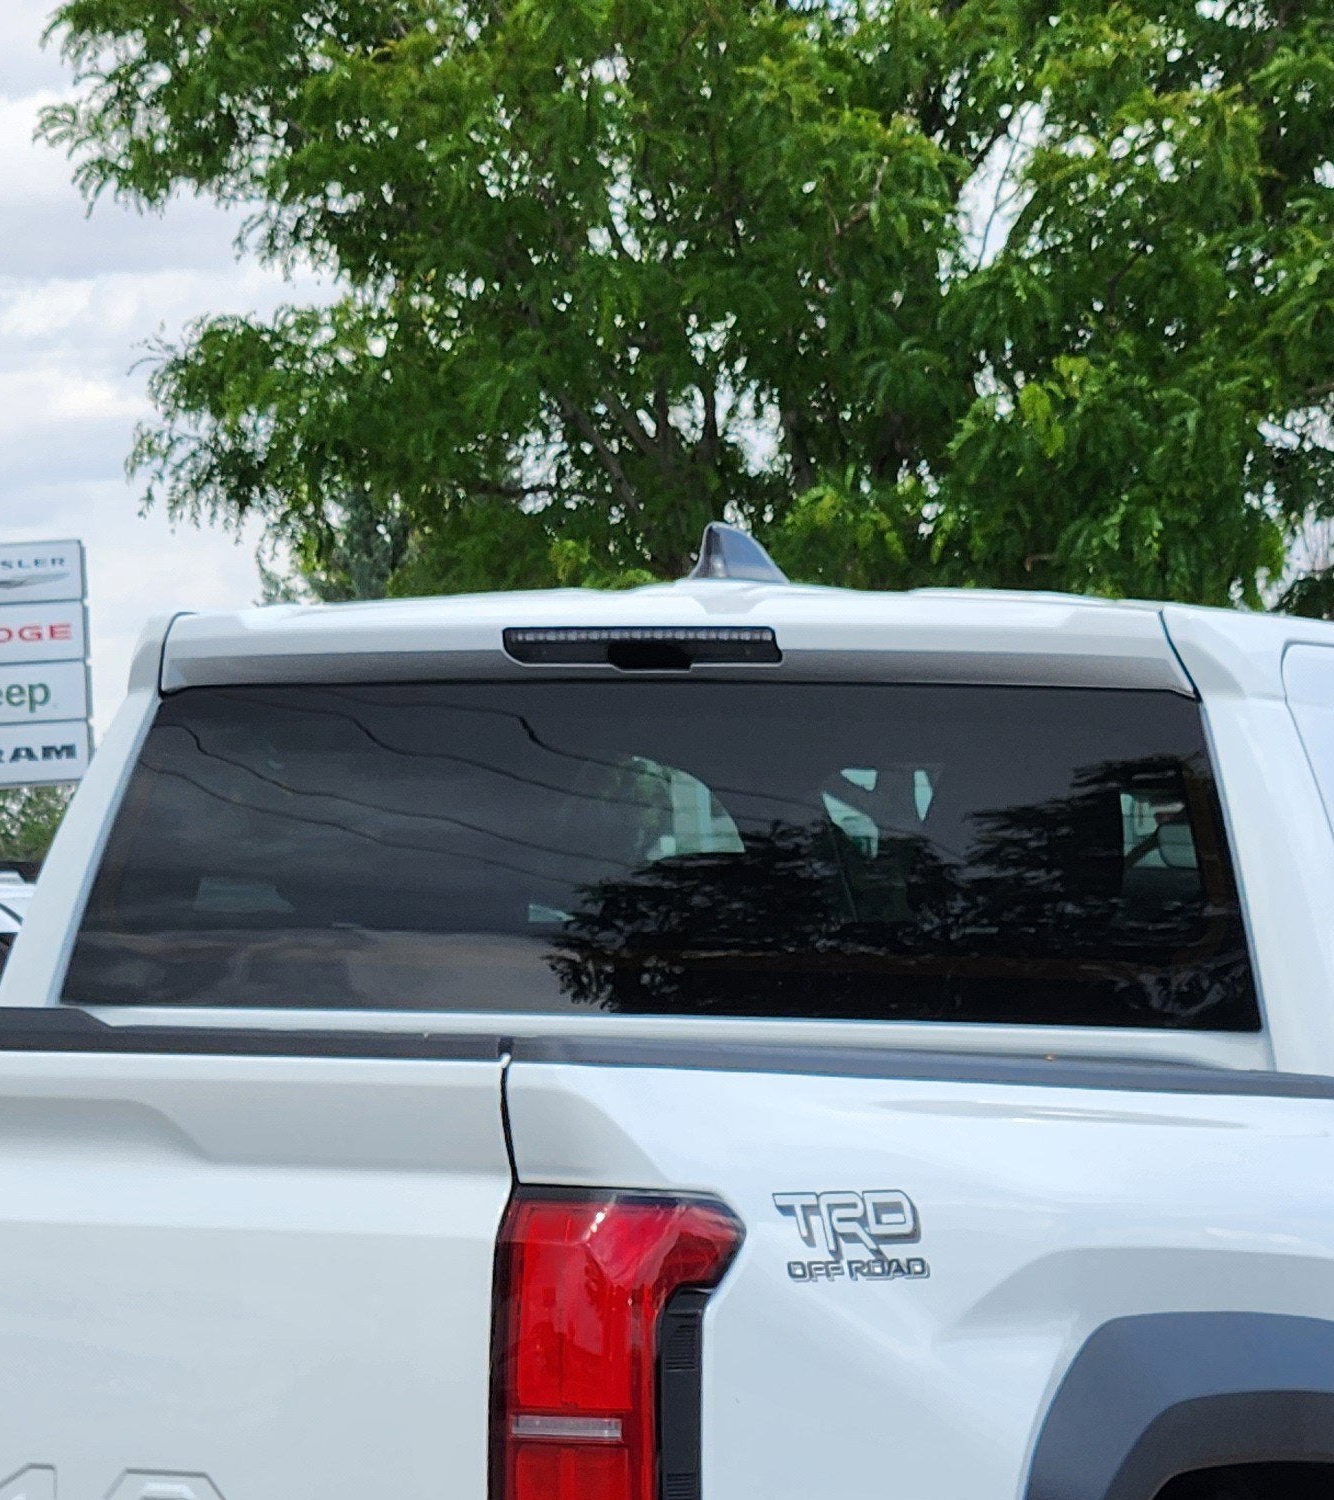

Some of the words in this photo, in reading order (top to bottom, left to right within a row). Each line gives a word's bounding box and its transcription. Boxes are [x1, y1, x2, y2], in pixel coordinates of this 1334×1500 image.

[771, 1189, 922, 1259] TRD
[786, 1260, 845, 1282] OFF
[846, 1257, 930, 1281] ROAD
